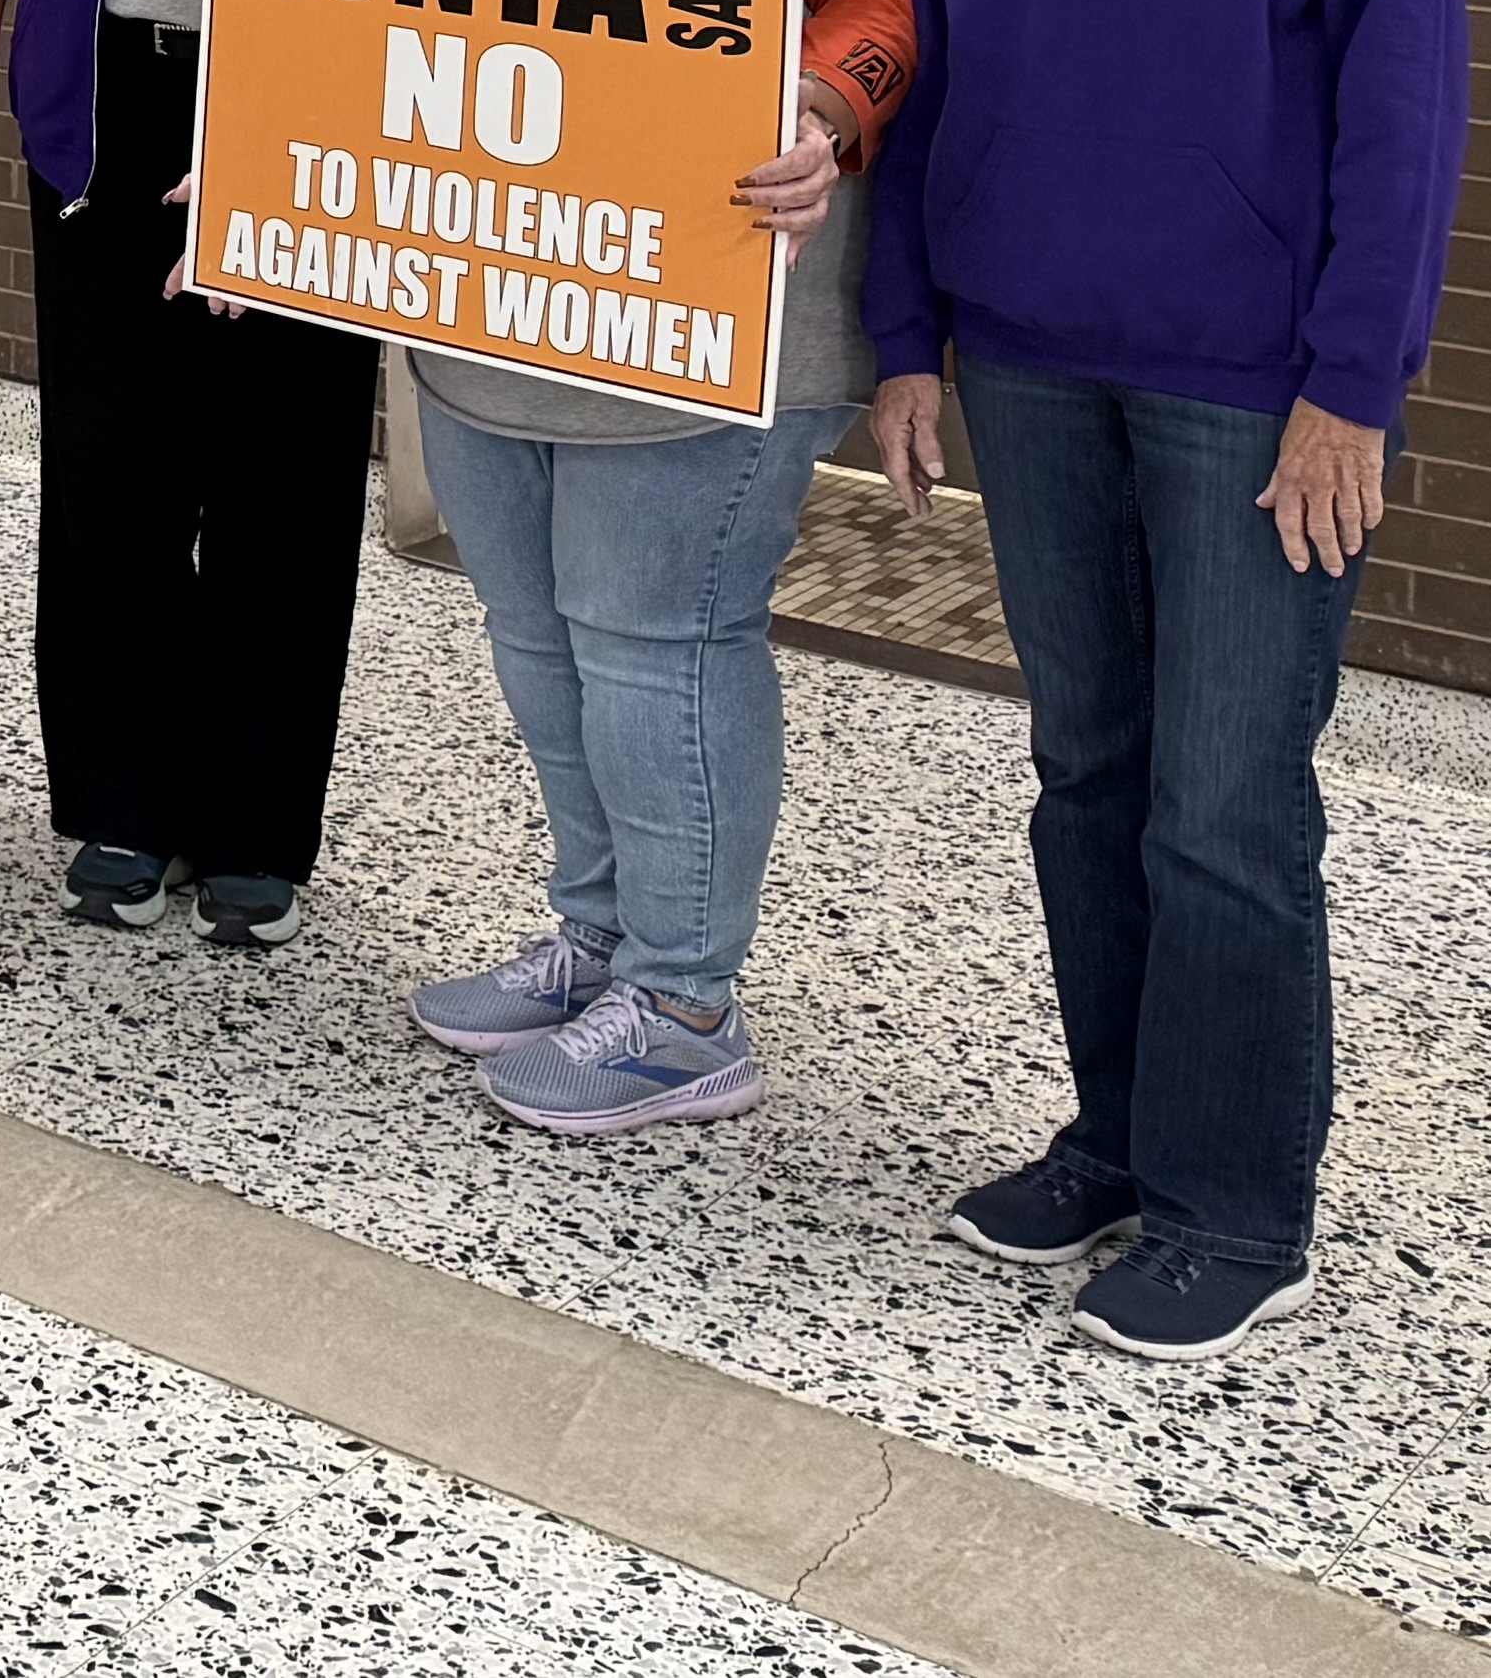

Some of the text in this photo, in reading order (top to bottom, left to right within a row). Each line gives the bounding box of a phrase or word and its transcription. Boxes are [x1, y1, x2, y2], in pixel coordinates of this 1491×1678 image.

[381, 24, 565, 166] NO
[287, 139, 665, 284] TO VIOLENCE
[219, 209, 736, 389] AGAINST WOMEN
